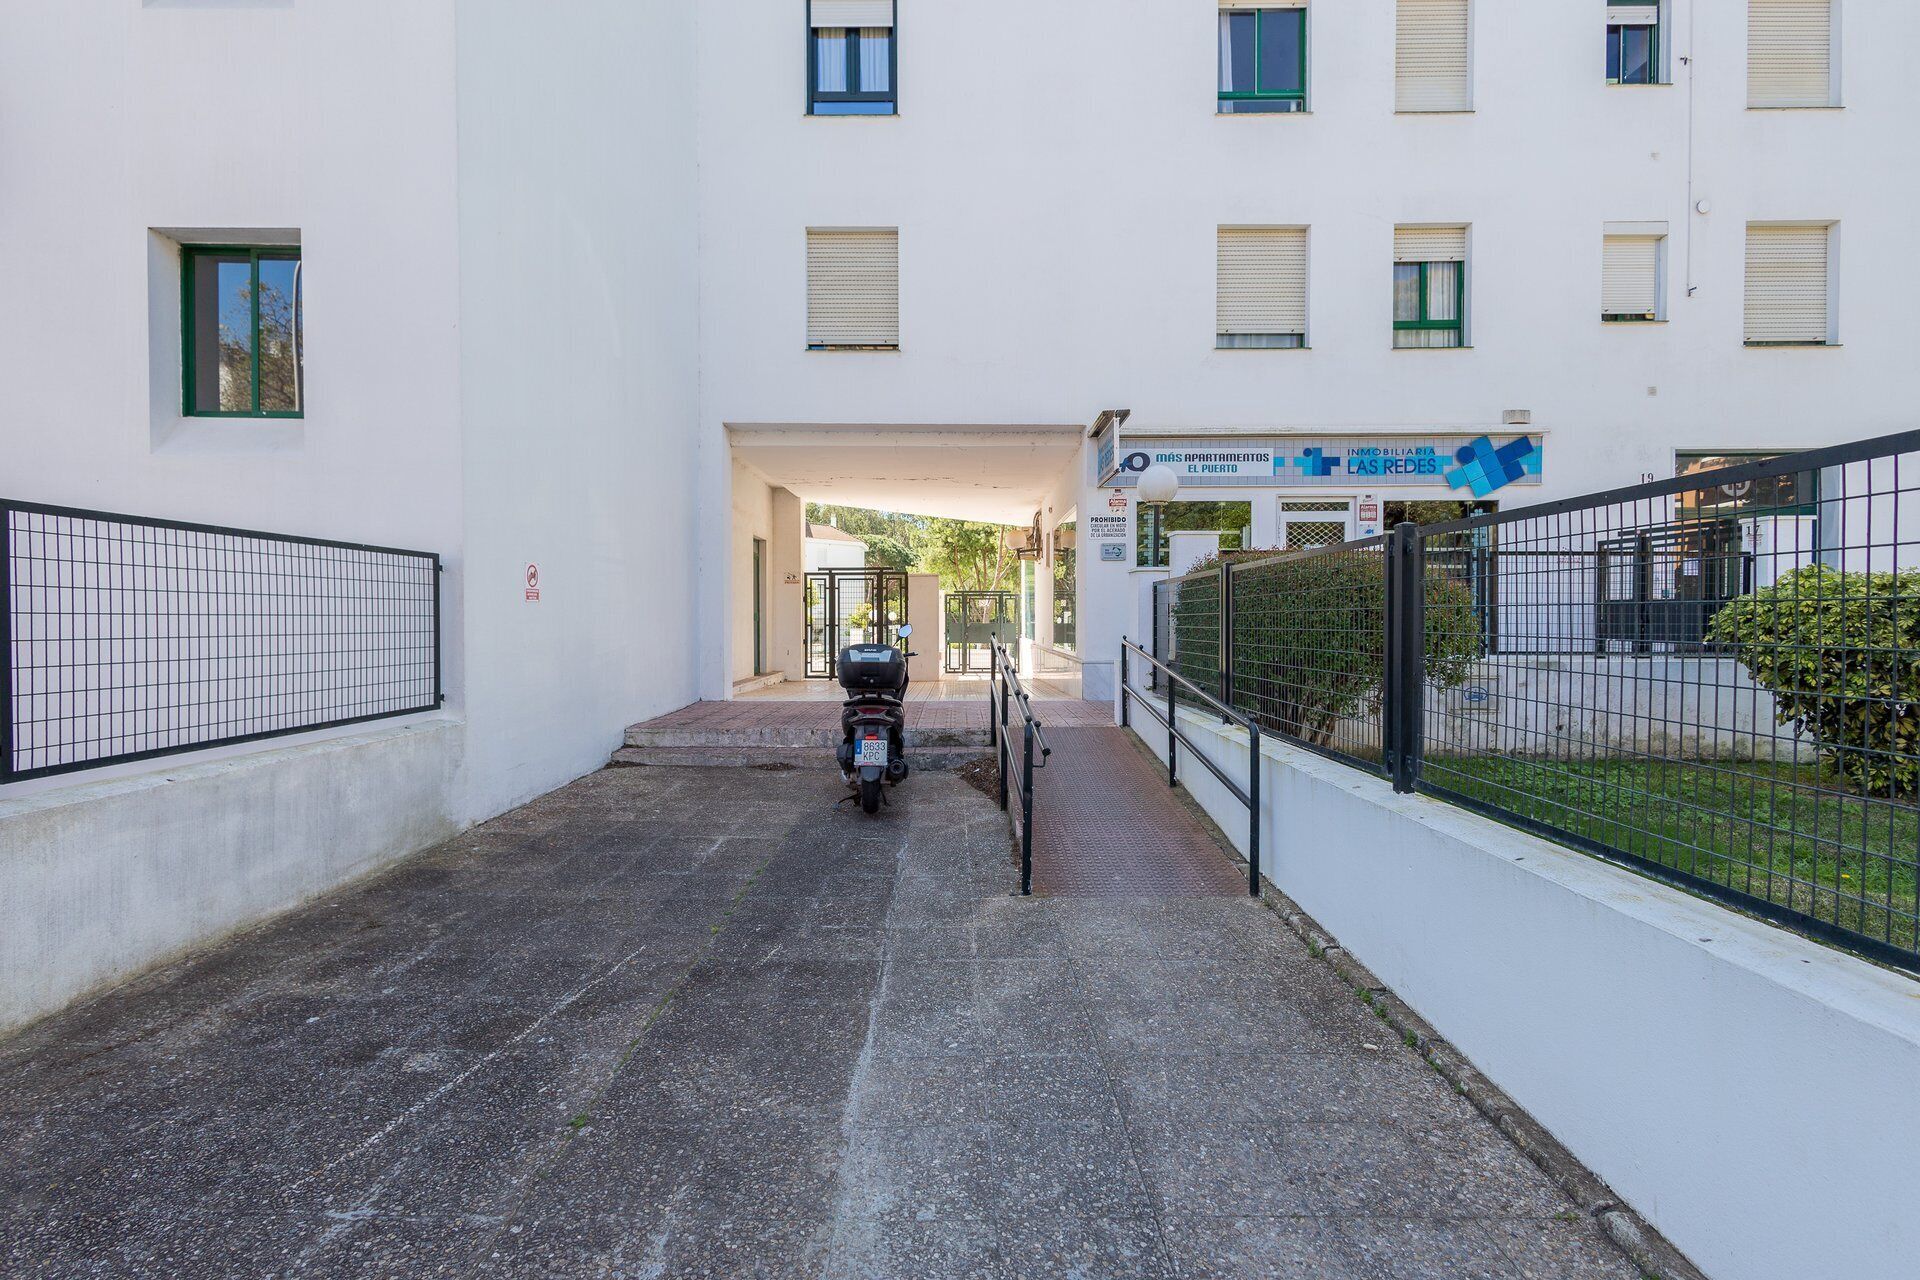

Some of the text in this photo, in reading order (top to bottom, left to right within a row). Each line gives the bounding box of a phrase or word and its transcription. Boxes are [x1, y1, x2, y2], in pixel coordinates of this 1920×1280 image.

[1347, 448, 1436, 456] INMOBILIARIA
[1156, 452, 1270, 462] MÁS APARTAMENTOS
[1188, 464, 1238, 473] EL PUERTO
[1347, 458, 1436, 474] LAS REDES
[1640, 473, 1654, 483] 19
[863, 742, 886, 751] 8633
[863, 752, 880, 761] KPC
